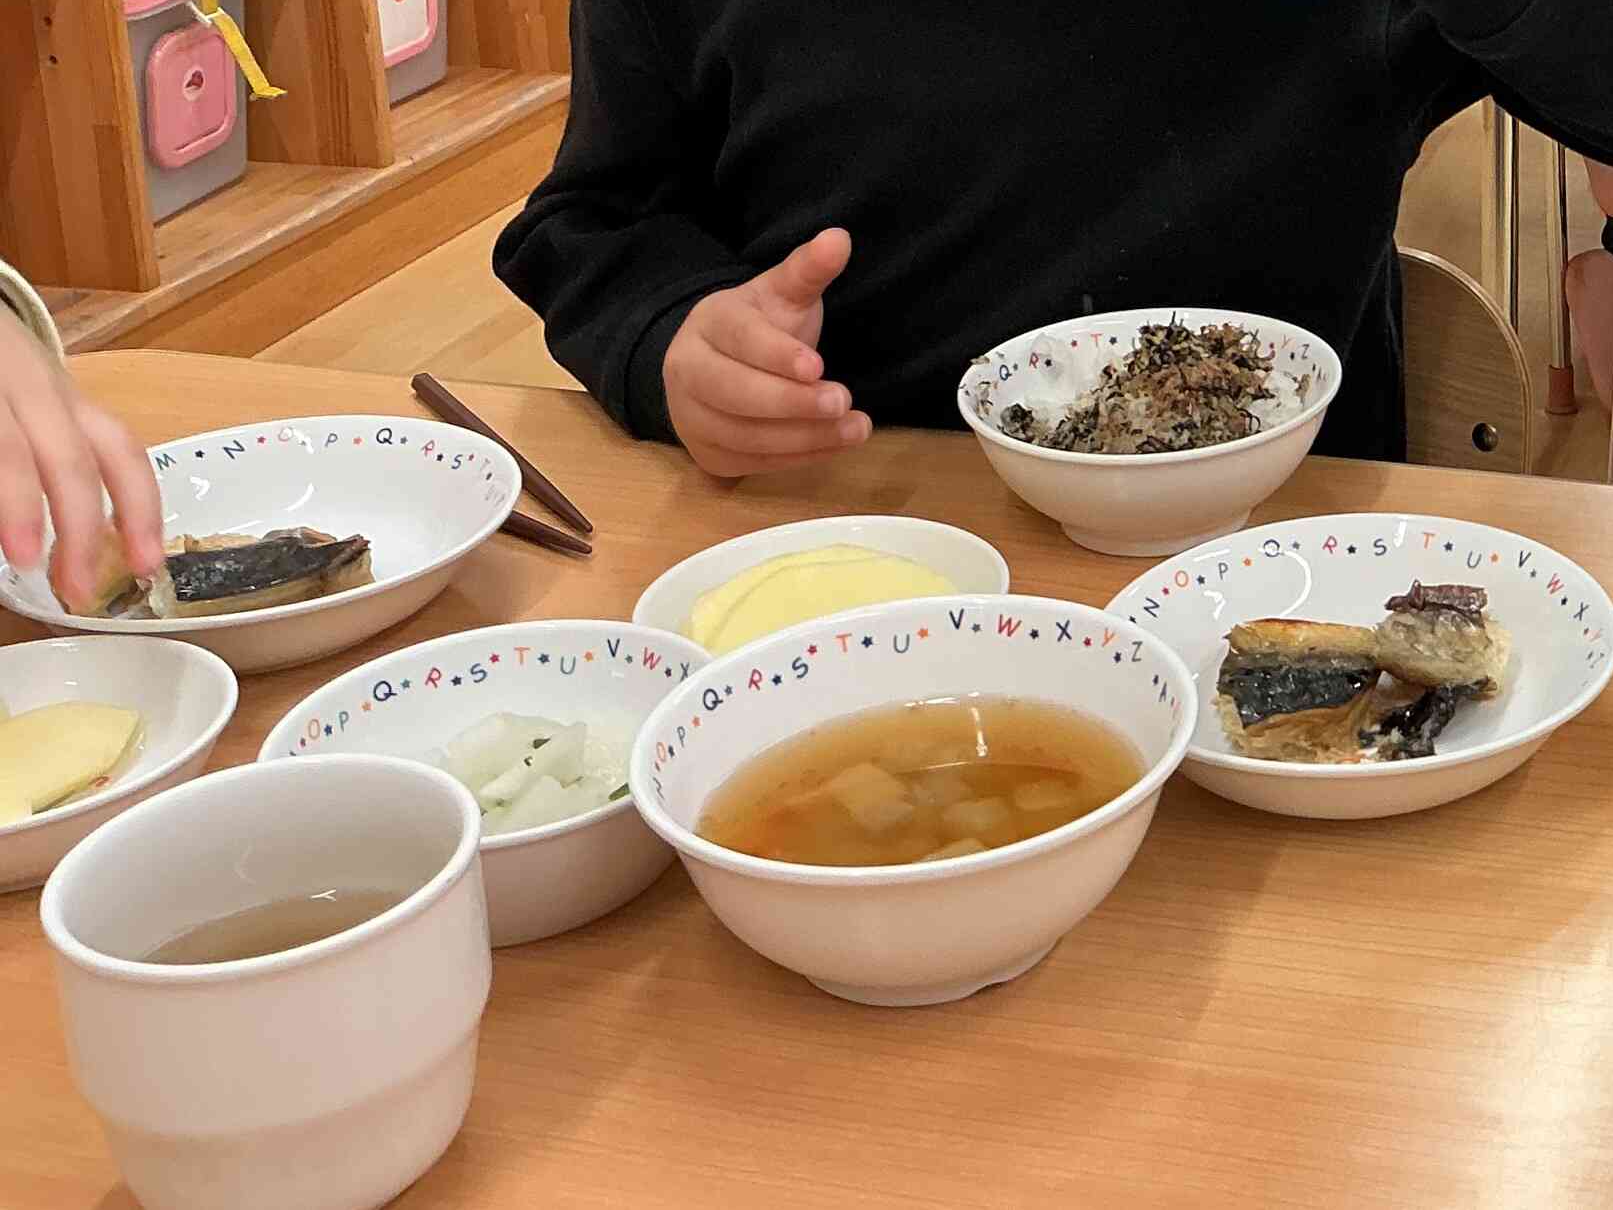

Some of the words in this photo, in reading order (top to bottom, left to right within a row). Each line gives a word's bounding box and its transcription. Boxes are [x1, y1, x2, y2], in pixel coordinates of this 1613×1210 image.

[999, 364, 1013, 381] Q
[1029, 352, 1039, 369] R
[1090, 333, 1103, 348] T
[1301, 343, 1310, 360] Z
[155, 453, 176, 470] M
[222, 440, 245, 459] N
[325, 433, 338, 447] P
[376, 428, 393, 445] Q
[421, 440, 436, 458] R
[451, 454, 463, 470] S
[1143, 597, 1160, 618] N
[1174, 570, 1189, 587] O
[1218, 562, 1229, 580] P
[1323, 535, 1338, 554] R
[1373, 538, 1387, 556] S
[1422, 533, 1436, 550] T
[1466, 550, 1482, 569] U
[1518, 550, 1532, 568] V
[1547, 573, 1564, 595] W
[1573, 602, 1589, 622] X
[307, 718, 321, 740] O
[338, 711, 349, 732] P
[373, 680, 398, 702] Q
[425, 667, 442, 689] R
[470, 662, 488, 683] S
[513, 646, 530, 665] T
[560, 656, 576, 675] U
[607, 638, 621, 657] V
[642, 646, 662, 671] W
[656, 742, 666, 763] O
[676, 726, 686, 748] P
[702, 688, 724, 711] Q
[748, 668, 763, 691] R
[791, 656, 809, 679] S
[835, 633, 853, 653] T
[893, 633, 911, 653] U
[949, 608, 965, 630] V
[997, 613, 1022, 637] W
[1056, 620, 1072, 642] X
[1102, 628, 1116, 647] Y
[1131, 641, 1143, 662] Z
